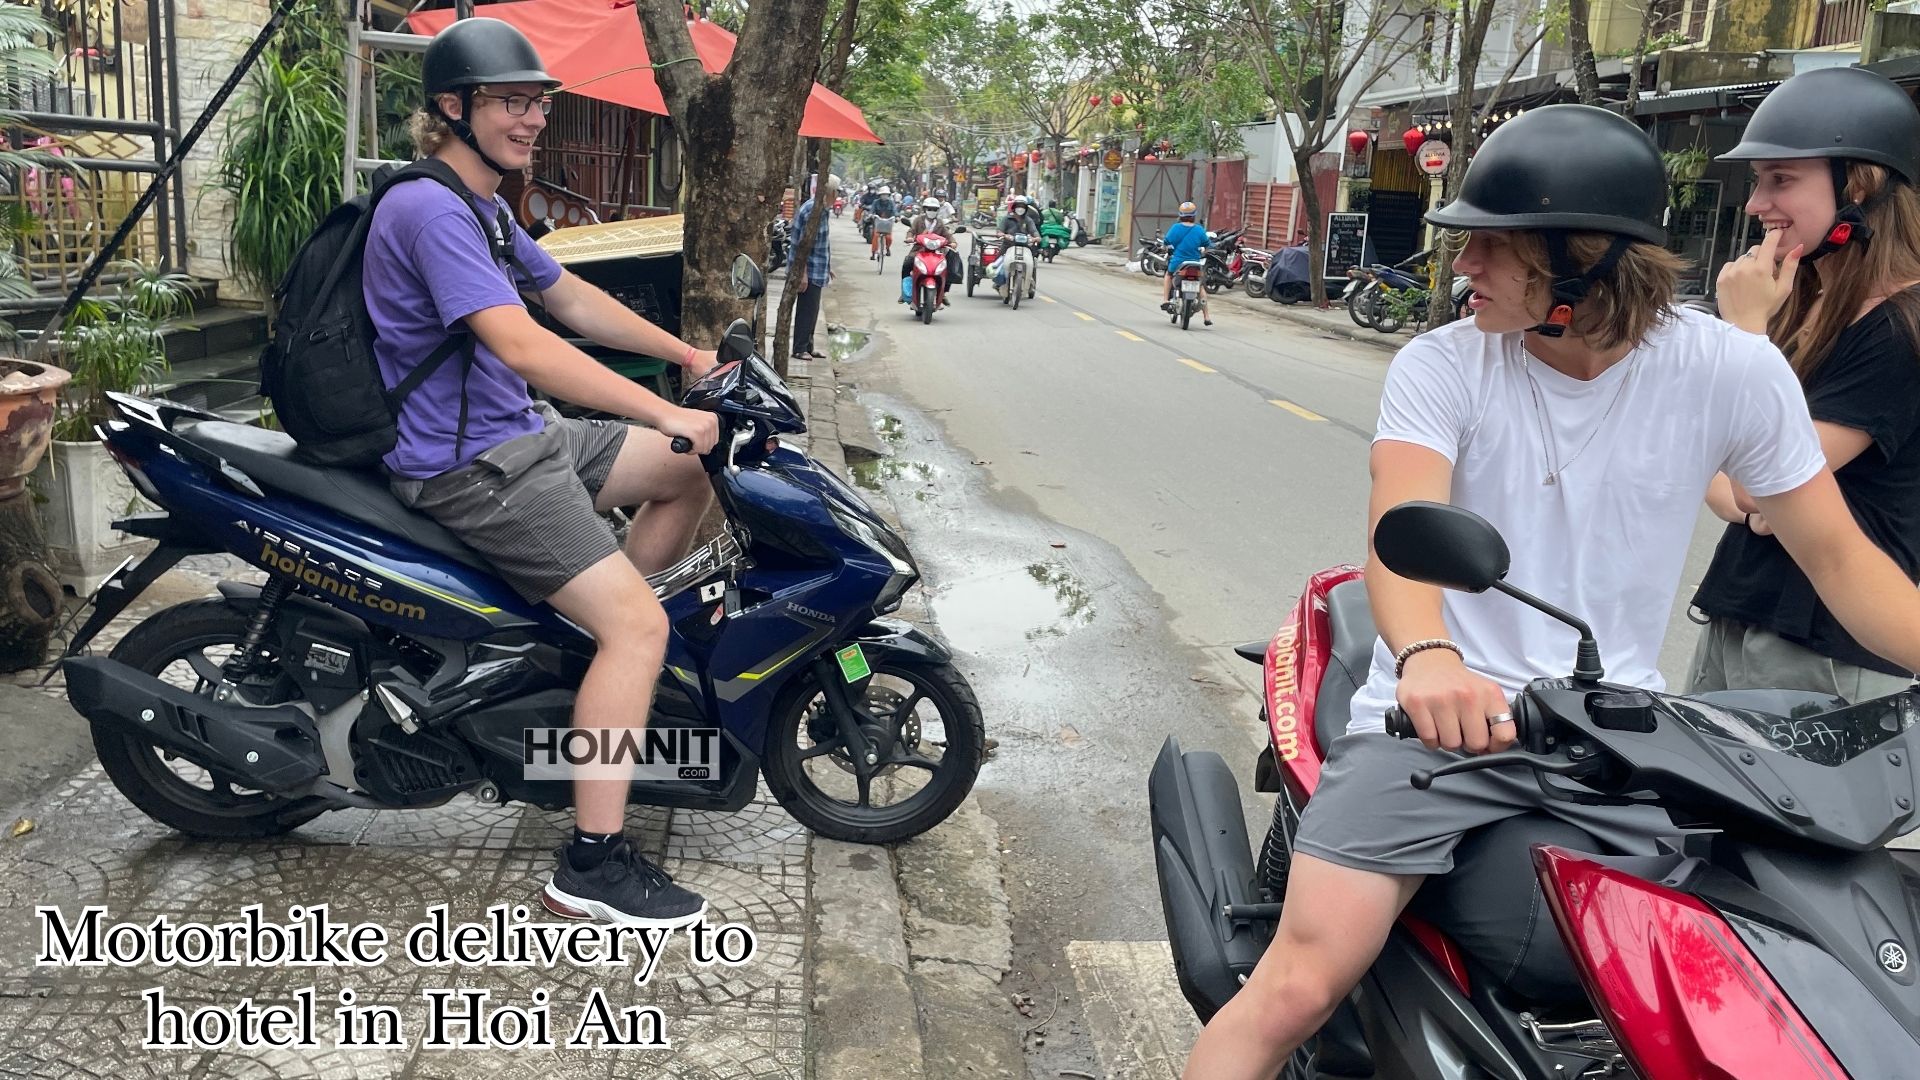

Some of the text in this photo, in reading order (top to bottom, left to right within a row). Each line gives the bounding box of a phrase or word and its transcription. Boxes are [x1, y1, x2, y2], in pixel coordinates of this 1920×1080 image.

[260, 542, 426, 621] hoianit.com
[785, 601, 837, 623] HONDA
[1275, 621, 1301, 763] hoianit.com
